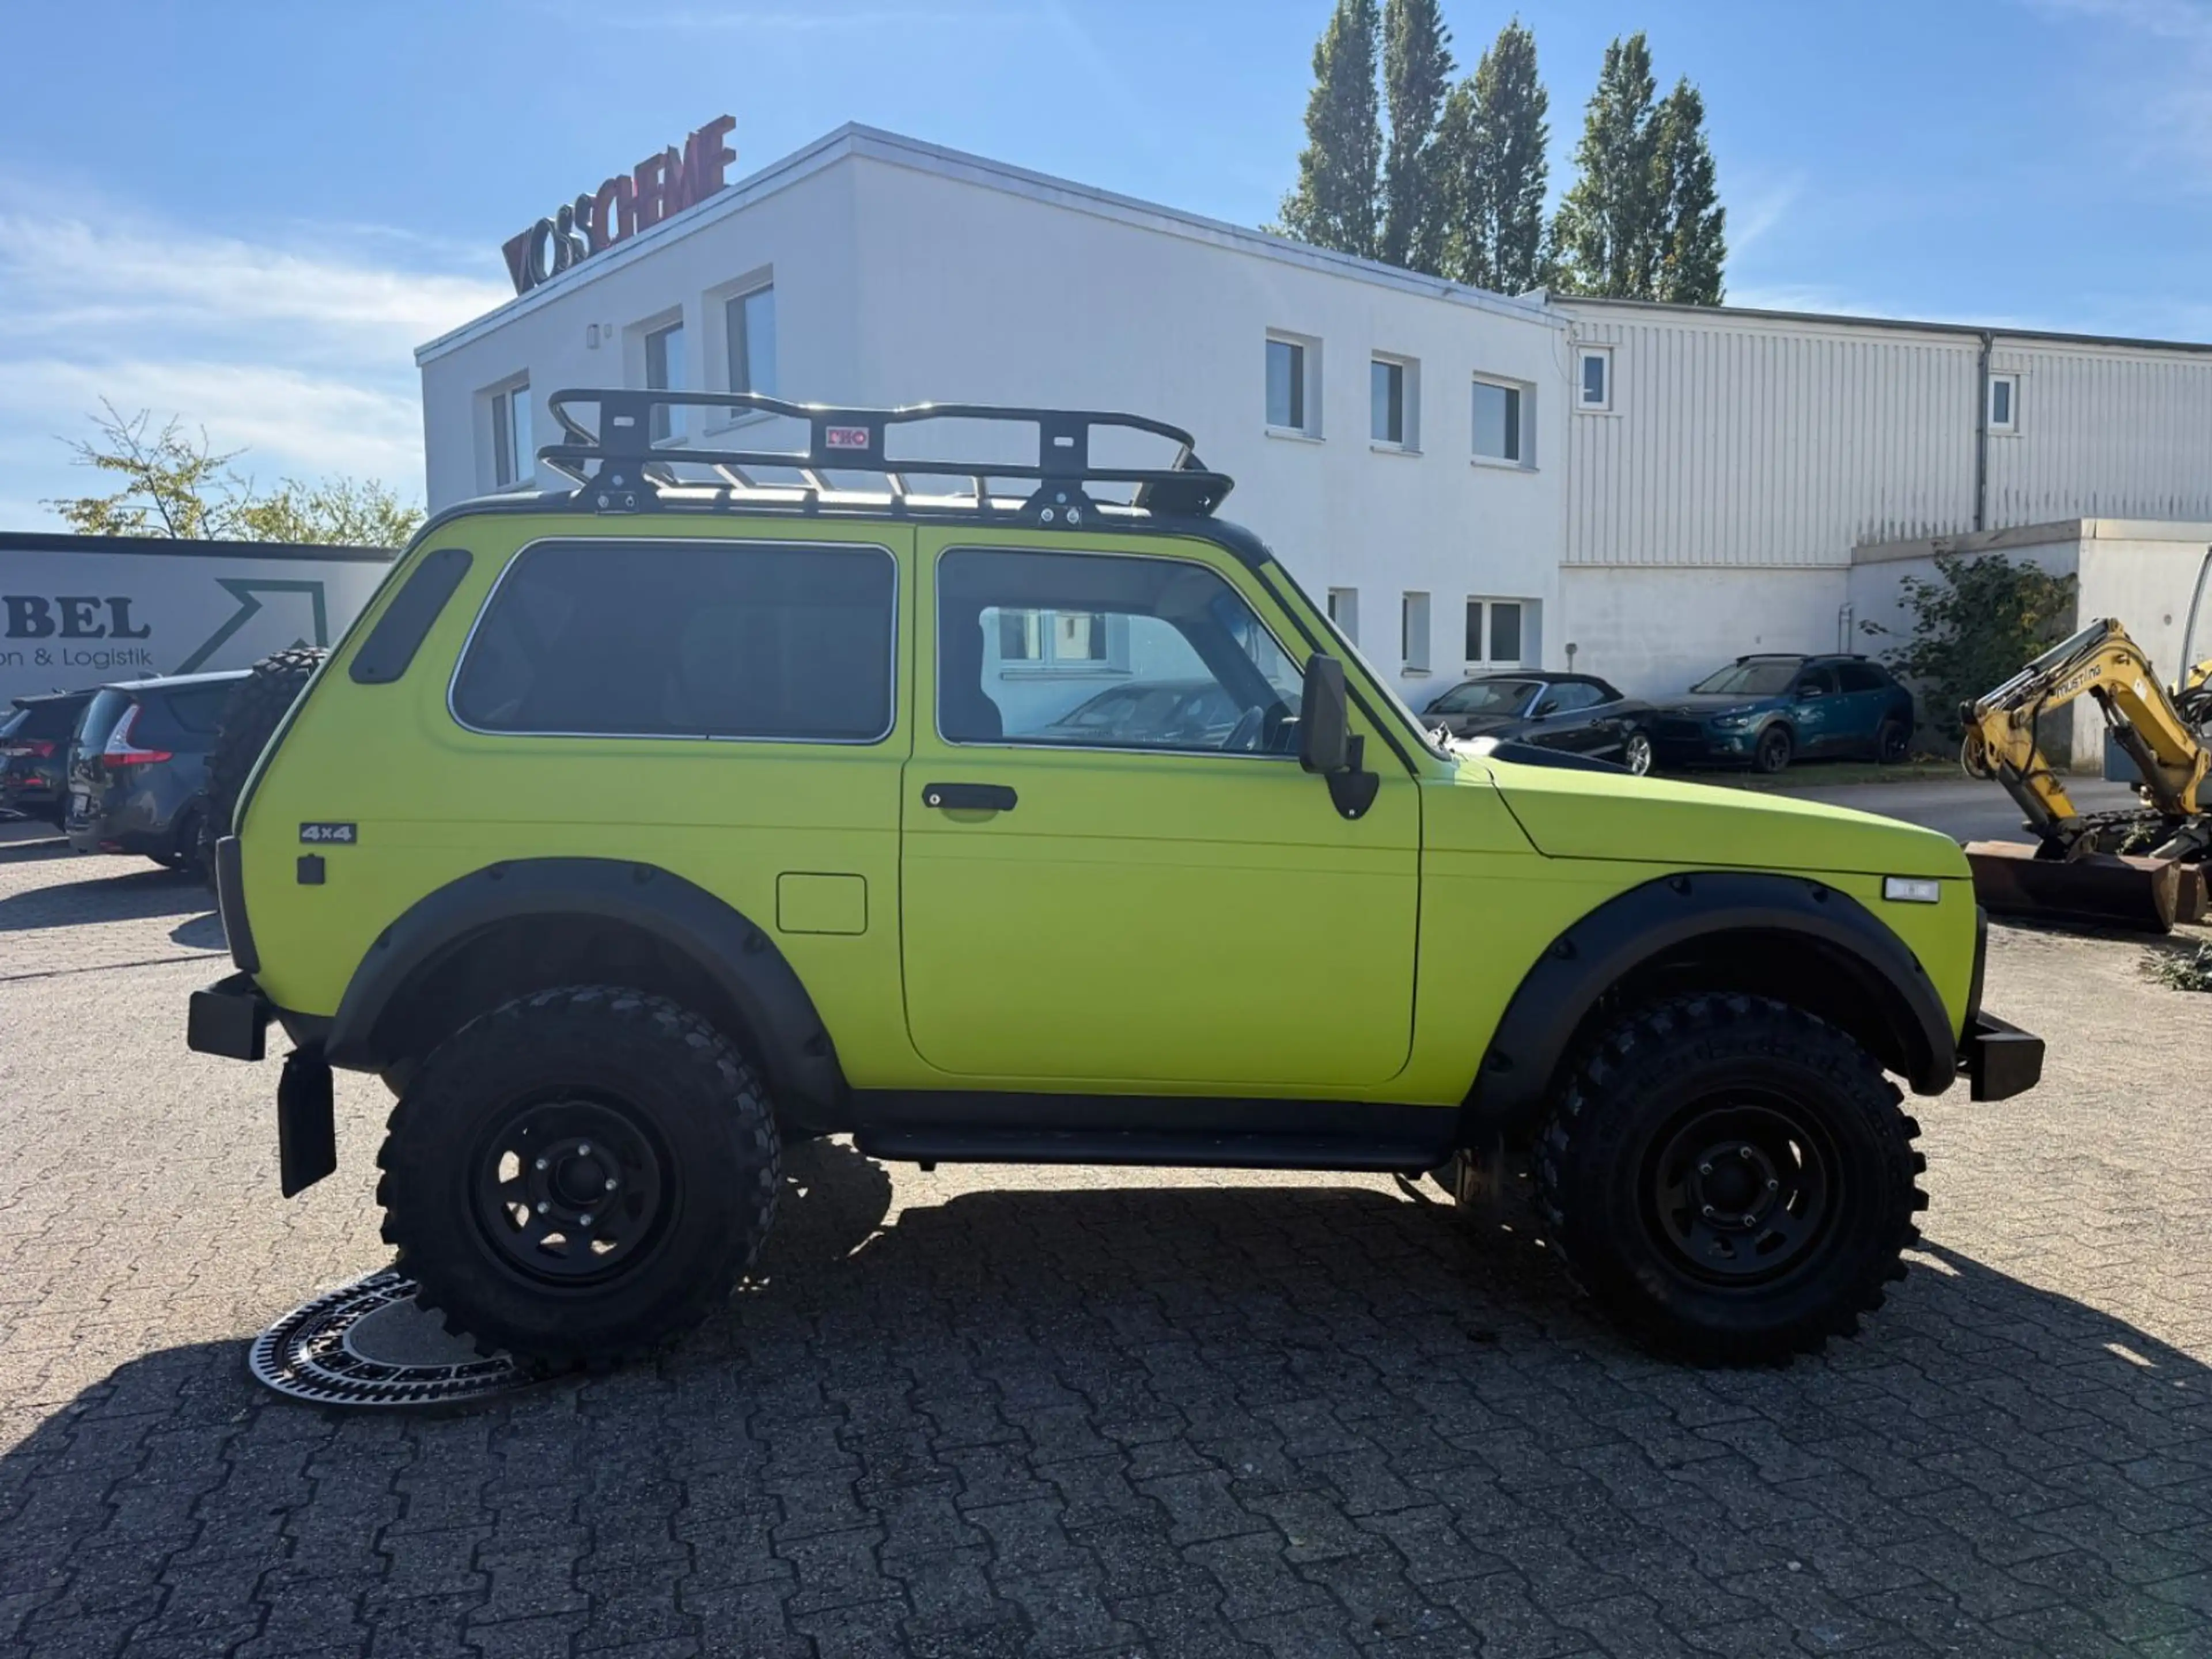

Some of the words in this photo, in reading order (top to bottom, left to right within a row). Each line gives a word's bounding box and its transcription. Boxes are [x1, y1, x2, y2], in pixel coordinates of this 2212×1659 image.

[2, 595, 152, 639] BEL
[35, 647, 54, 666] &
[63, 647, 153, 669] Logistik
[301, 825, 352, 841] 4x4
